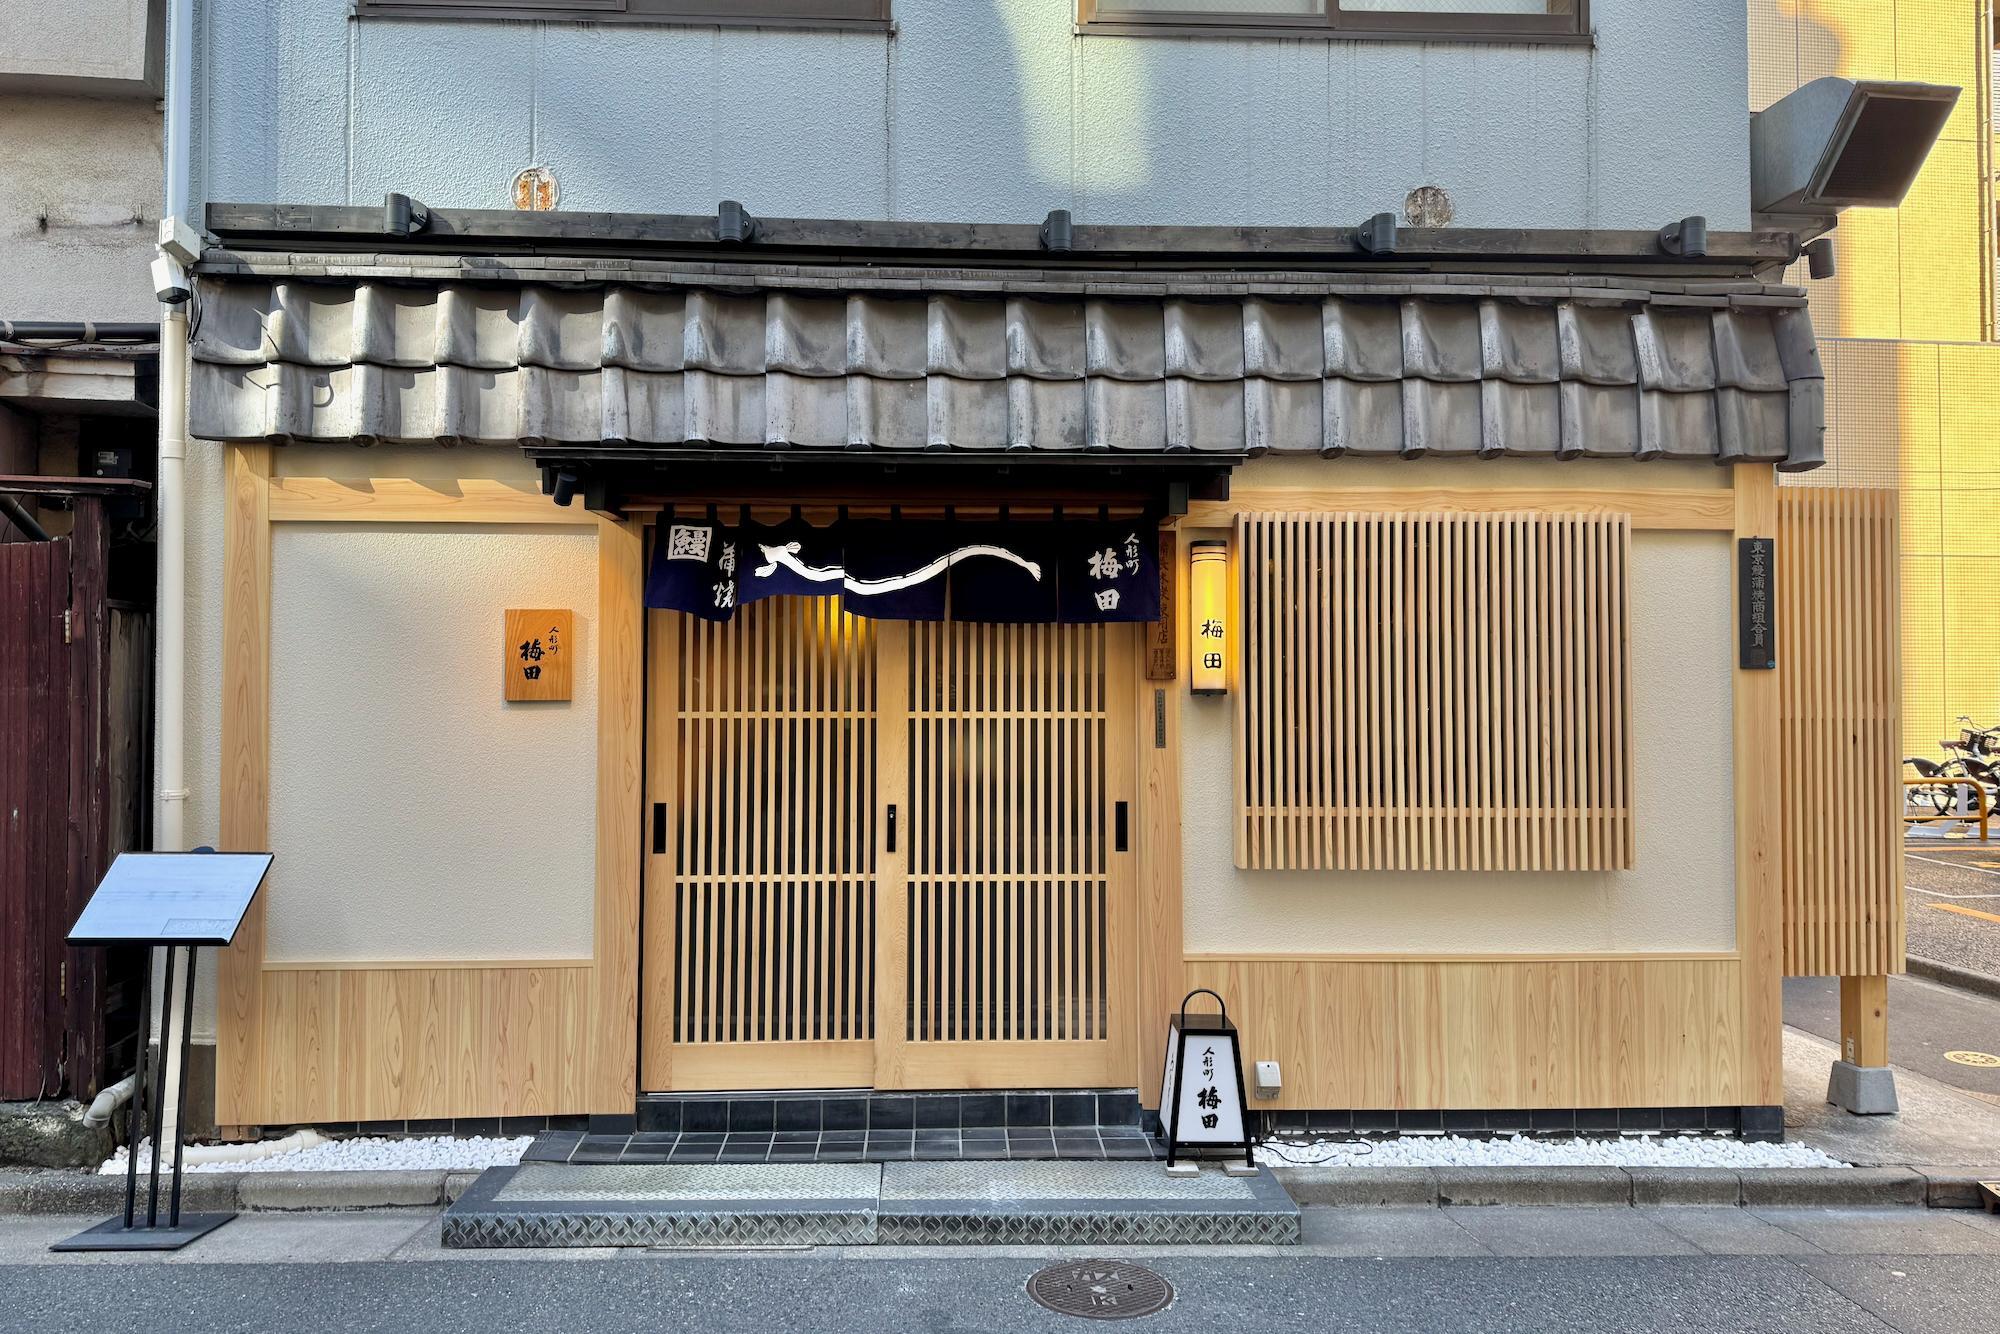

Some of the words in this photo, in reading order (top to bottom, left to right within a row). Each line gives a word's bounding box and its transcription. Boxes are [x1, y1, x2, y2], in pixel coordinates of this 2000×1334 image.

[673, 527, 709, 558] 鰻
[1124, 533, 1140, 576] 人形町
[1087, 547, 1124, 612] 梅田
[519, 638, 546, 681] 梅田
[548, 626, 560, 656] 人形町
[1200, 619, 1224, 669] 梅田
[1202, 1046, 1215, 1082] 人形町
[1196, 1086, 1222, 1129] 梅田
